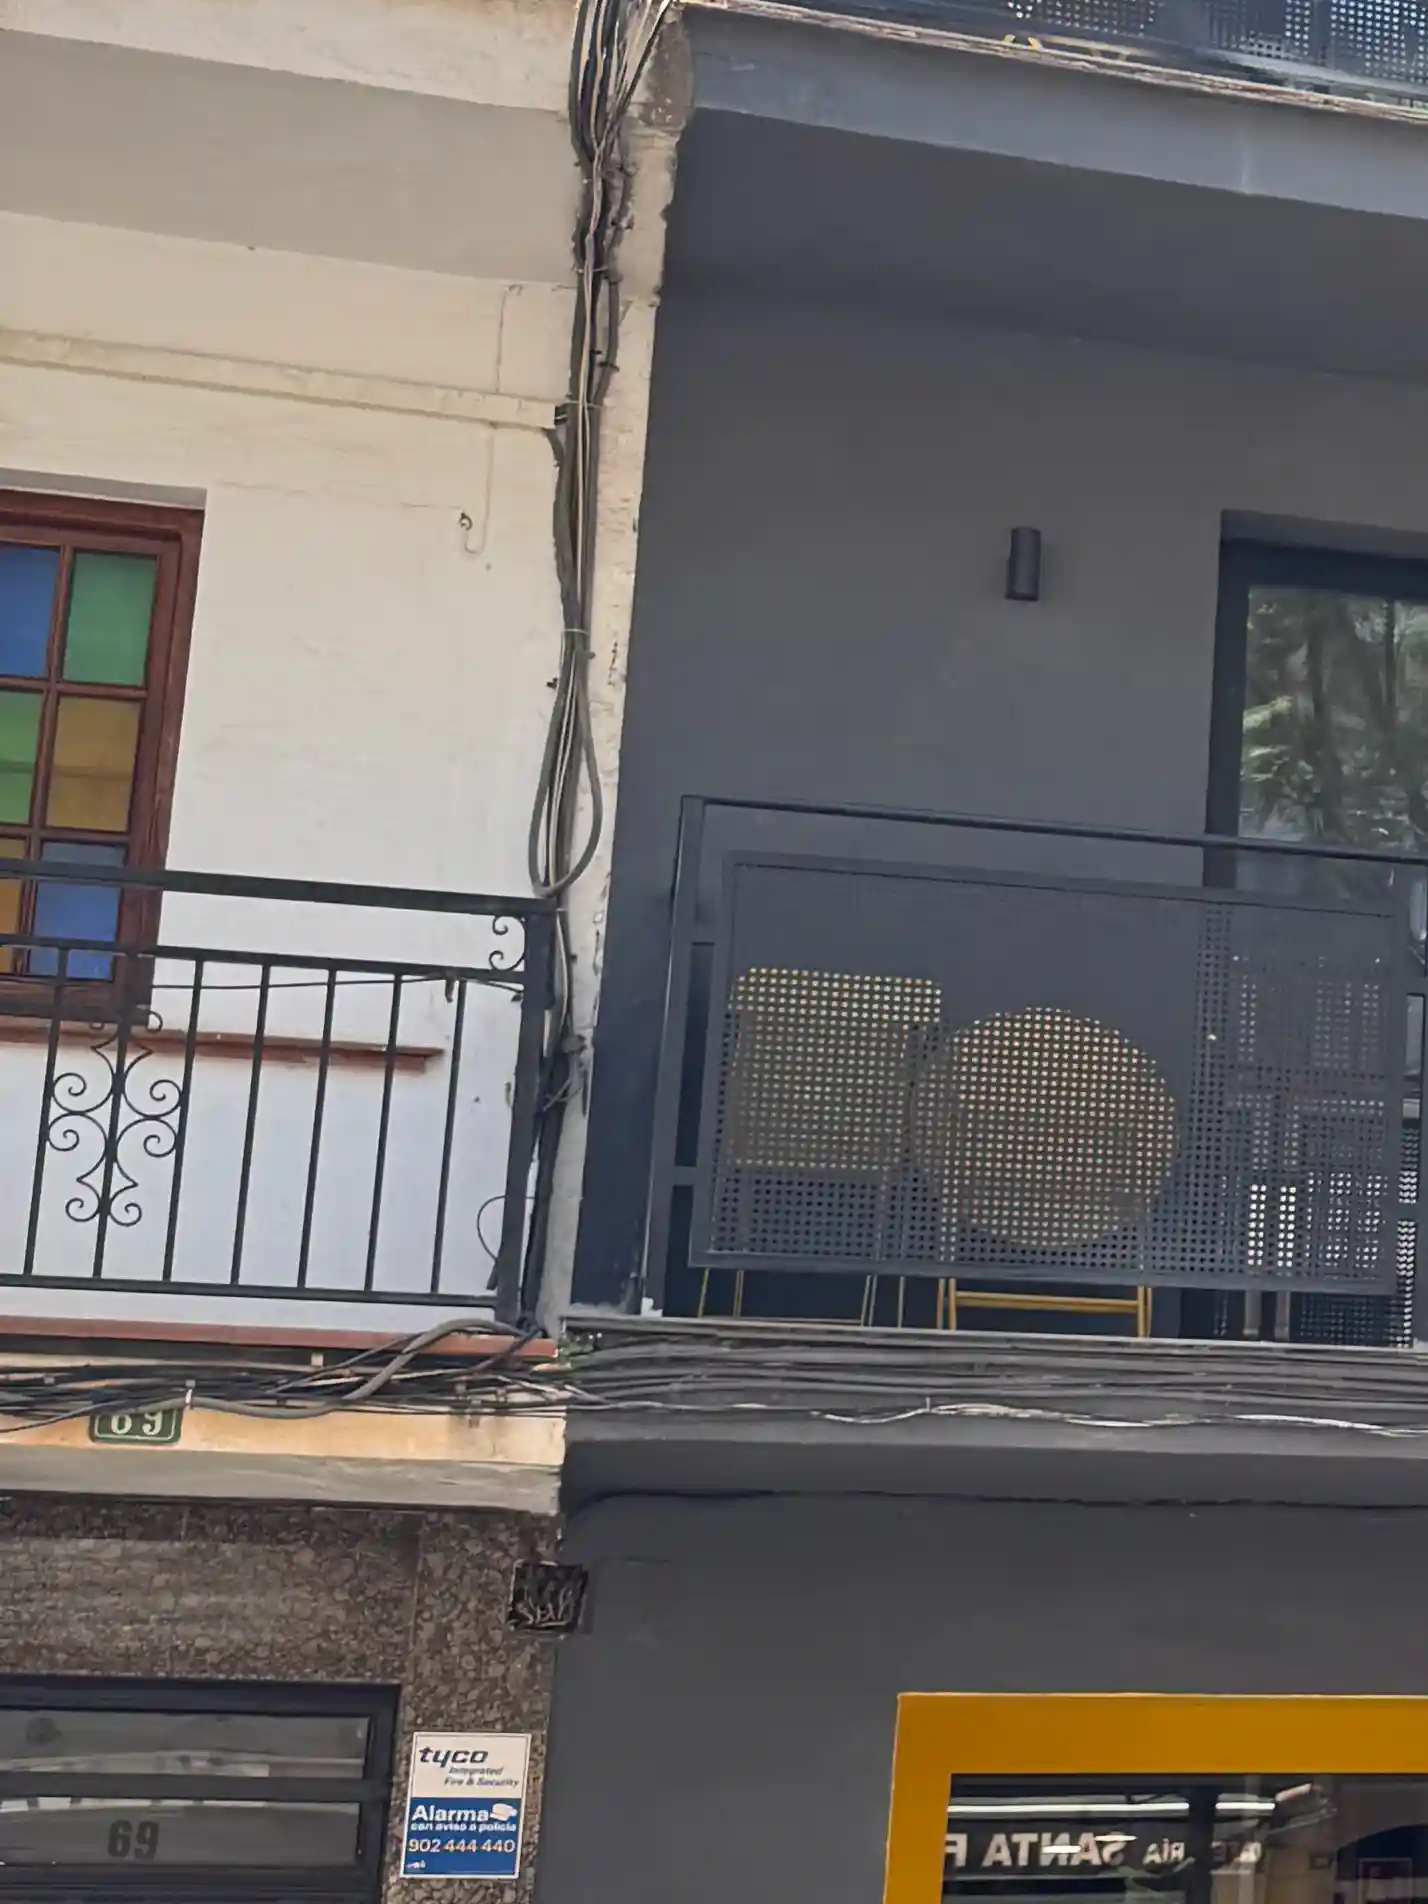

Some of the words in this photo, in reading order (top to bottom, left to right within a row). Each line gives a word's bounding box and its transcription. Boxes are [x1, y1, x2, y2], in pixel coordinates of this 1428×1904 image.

[418, 1746, 489, 1768] tyco
[448, 1766, 504, 1776] Integrated
[444, 1778, 463, 1786] Fire
[466, 1778, 475, 1786] &
[477, 1778, 519, 1787] Security
[412, 1804, 489, 1821] Alarma
[410, 1823, 433, 1831] con
[435, 1823, 467, 1831] aviso
[107, 1818, 159, 1861] 69
[408, 1838, 441, 1853] 902
[444, 1838, 477, 1853] 444
[480, 1838, 516, 1853] 440
